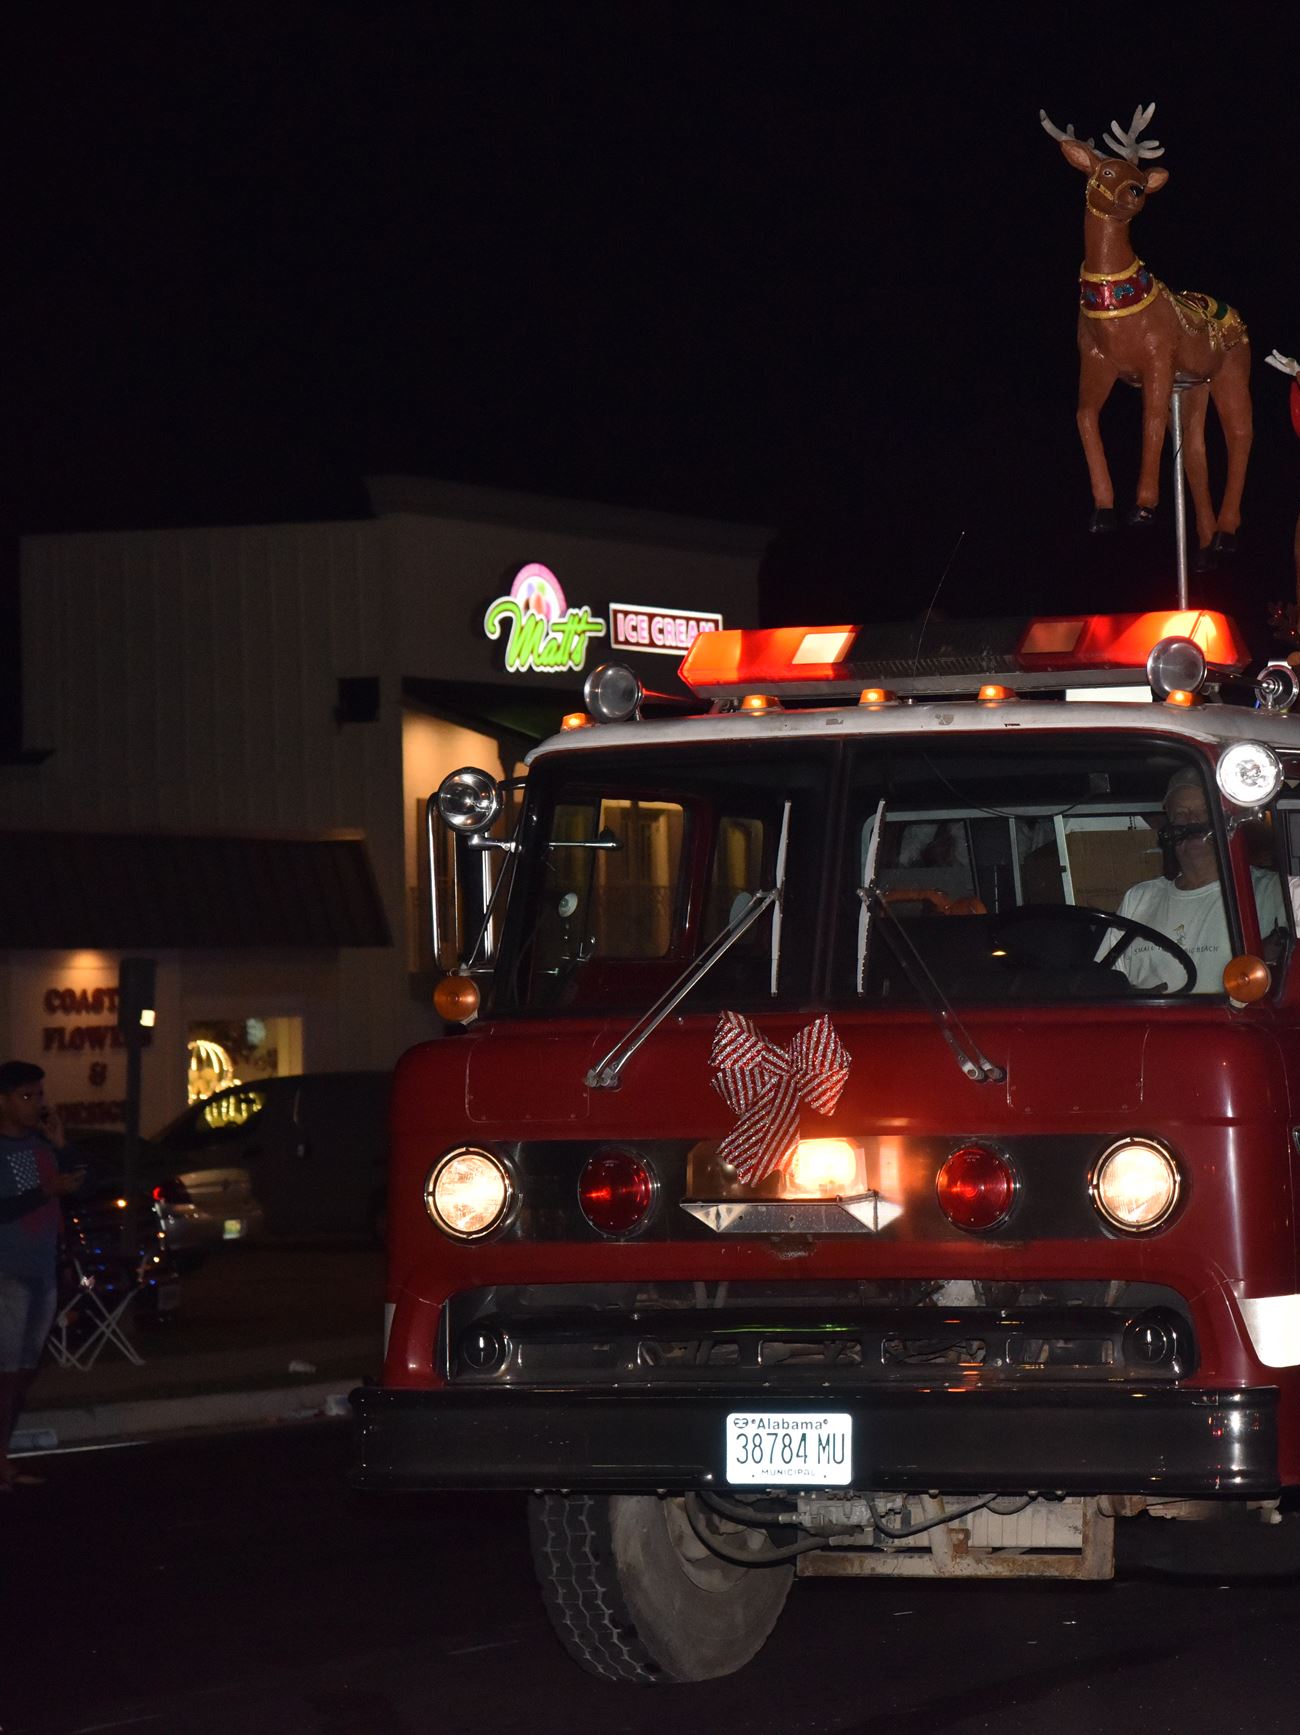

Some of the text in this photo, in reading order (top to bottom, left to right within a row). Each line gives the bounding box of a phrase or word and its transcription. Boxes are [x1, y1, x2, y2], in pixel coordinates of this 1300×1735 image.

[617, 613, 649, 643] ICE
[757, 1418, 823, 1431] Alabama
[736, 1432, 845, 1465] 38784 MU
[761, 1468, 816, 1476] MUNICIPAL
